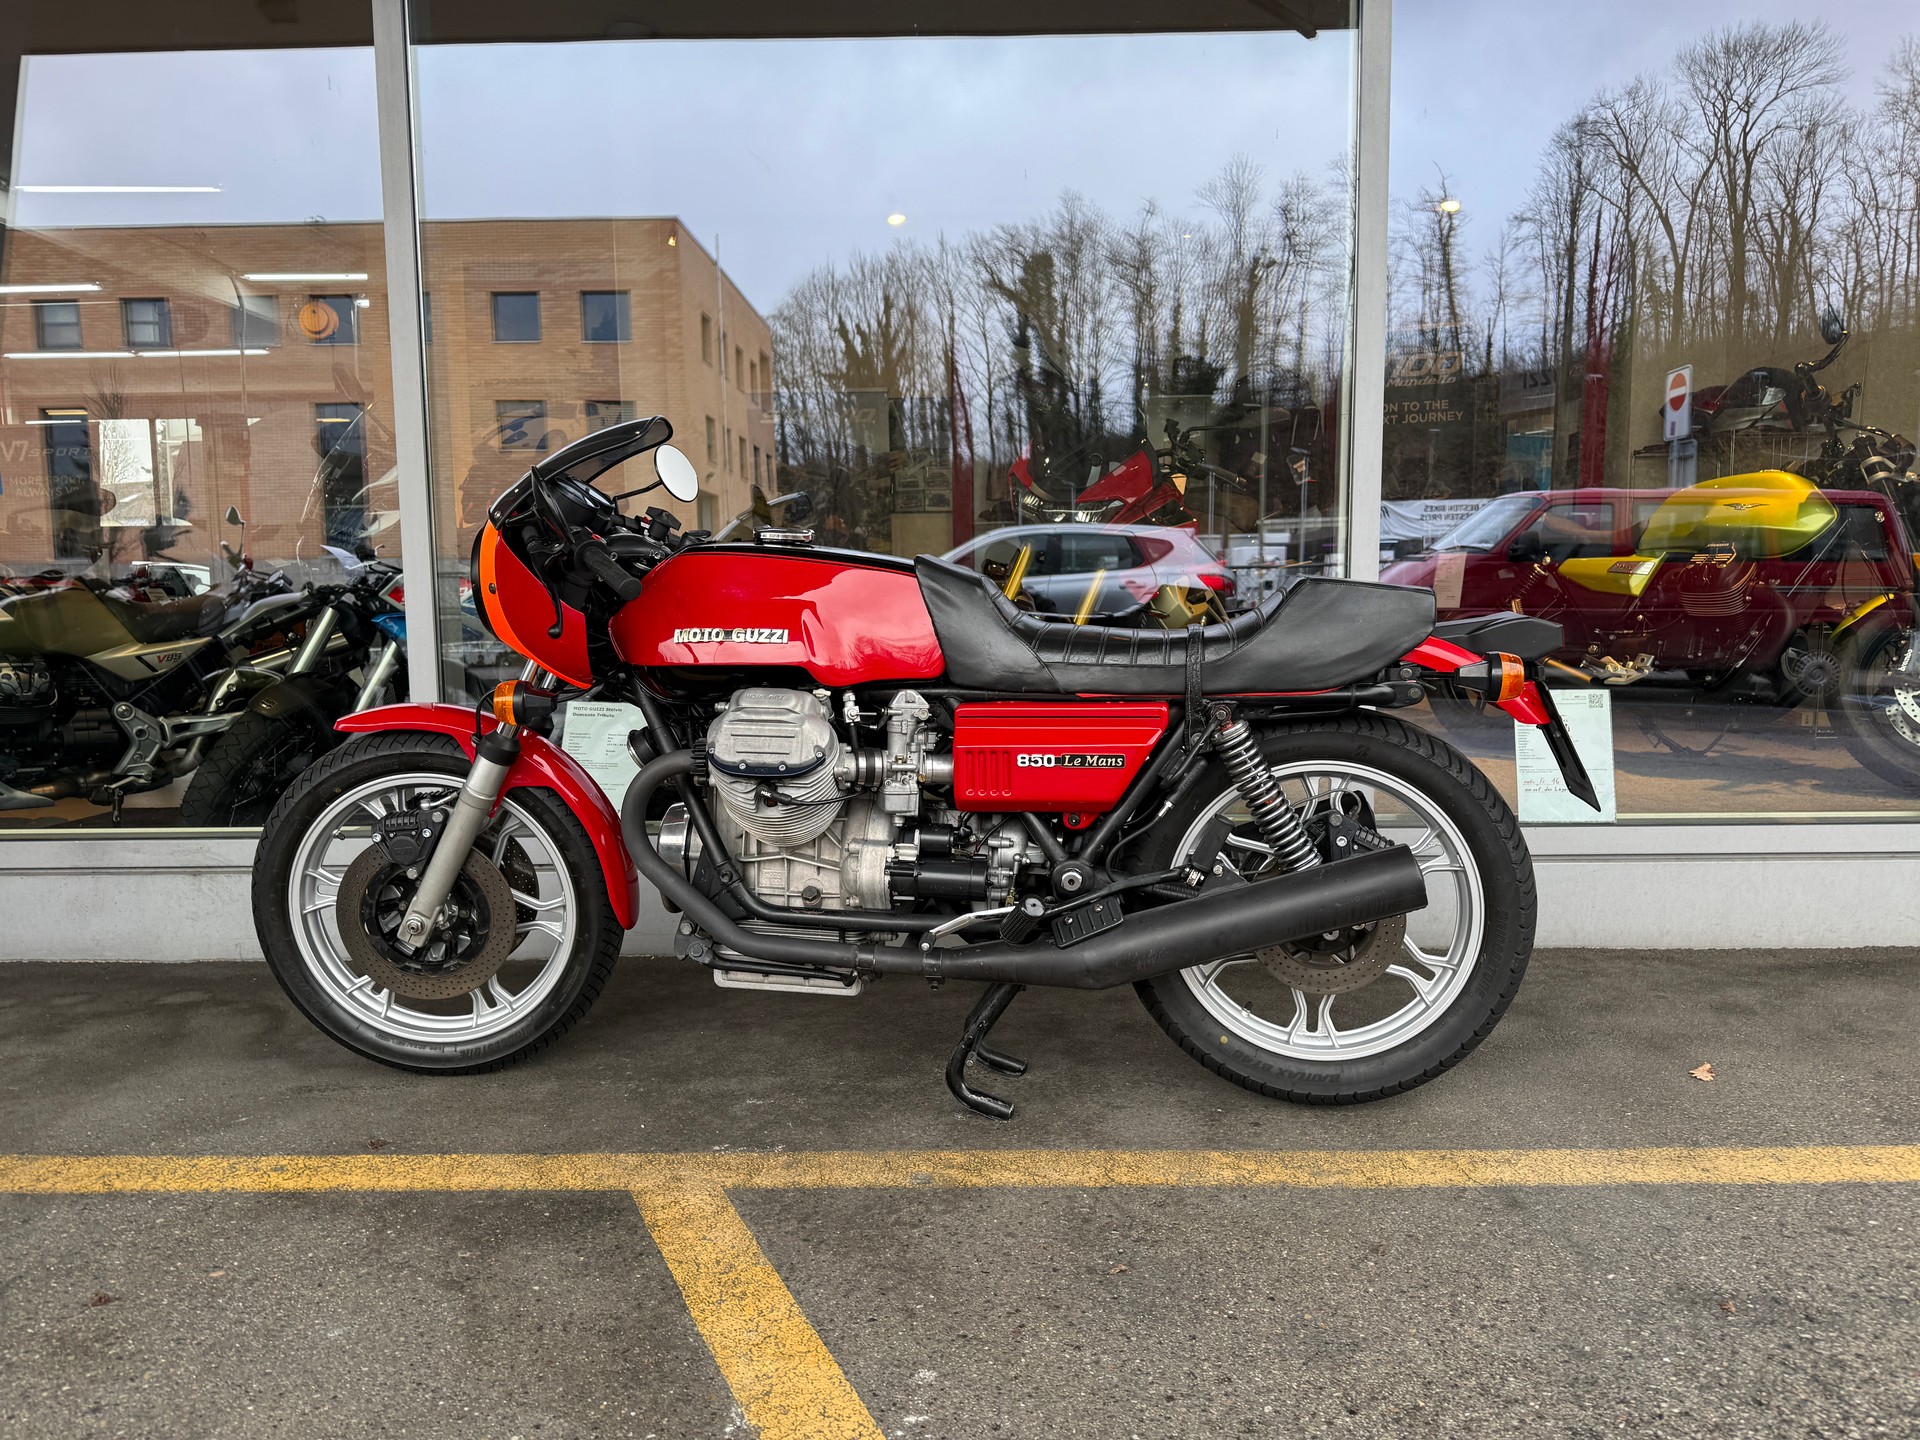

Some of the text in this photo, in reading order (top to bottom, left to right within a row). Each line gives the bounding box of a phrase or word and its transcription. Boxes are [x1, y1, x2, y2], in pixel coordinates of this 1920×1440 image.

[1402, 401, 1420, 412] TO
[1424, 399, 1449, 410] THE
[1383, 410, 1464, 425] XT JOURNEY
[0, 440, 29, 461] V7
[673, 627, 789, 644] MOTO GUZZI
[1017, 753, 1124, 768] 850 Le Mans
